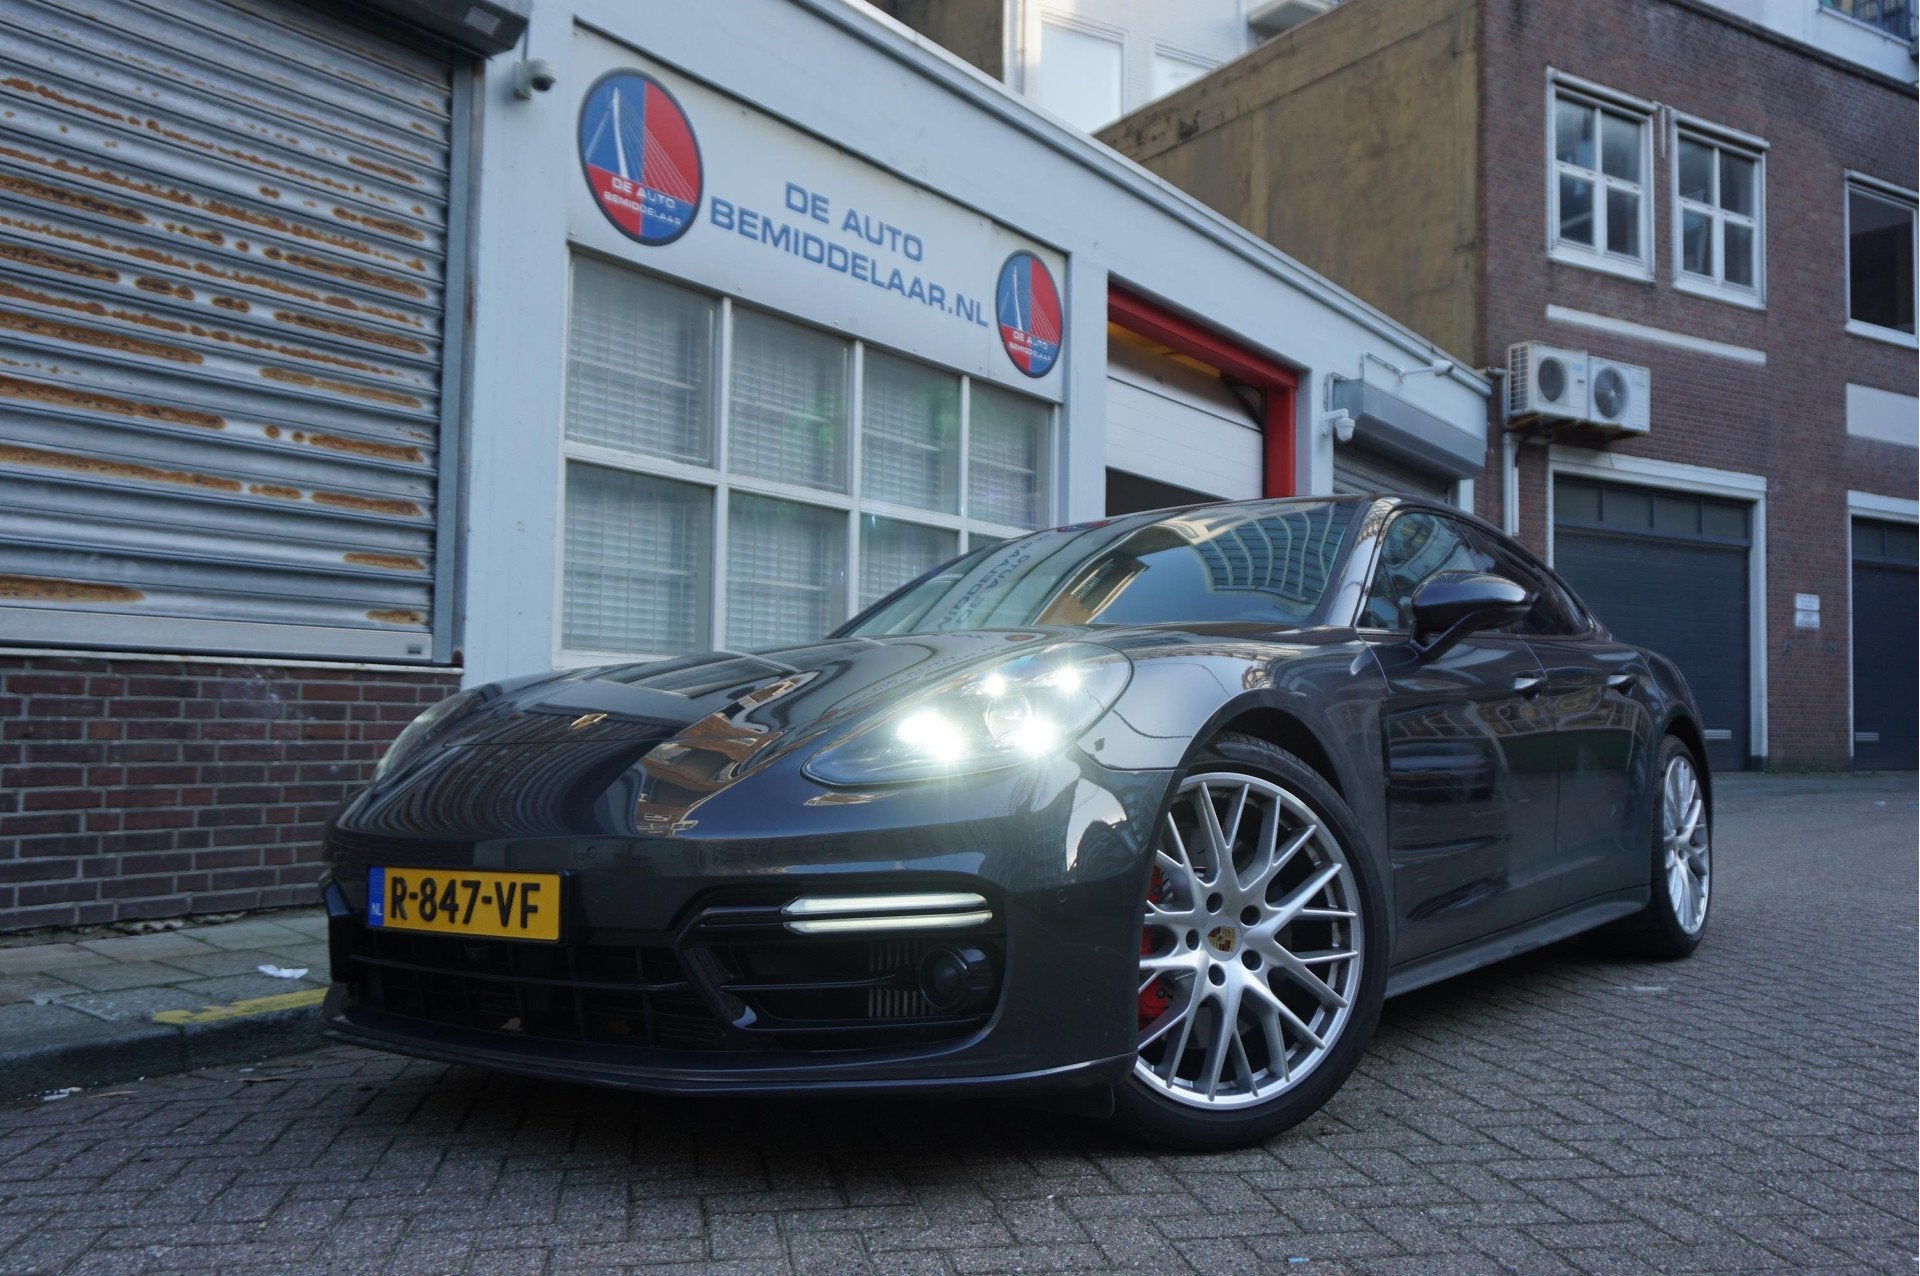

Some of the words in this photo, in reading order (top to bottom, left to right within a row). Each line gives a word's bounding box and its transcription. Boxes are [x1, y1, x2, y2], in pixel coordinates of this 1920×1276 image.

[603, 190, 682, 226] BEMIDDELAAR
[611, 176, 633, 193] DE
[636, 187, 676, 209] AUTO
[785, 181, 830, 224] DE
[841, 207, 923, 262] AUTO
[710, 195, 989, 328] BEMIDDELAAR.NL
[1013, 330, 1025, 342] DE
[1026, 336, 1048, 350] AUTO
[371, 902, 383, 916] NL
[390, 876, 541, 929] R-847-VF
